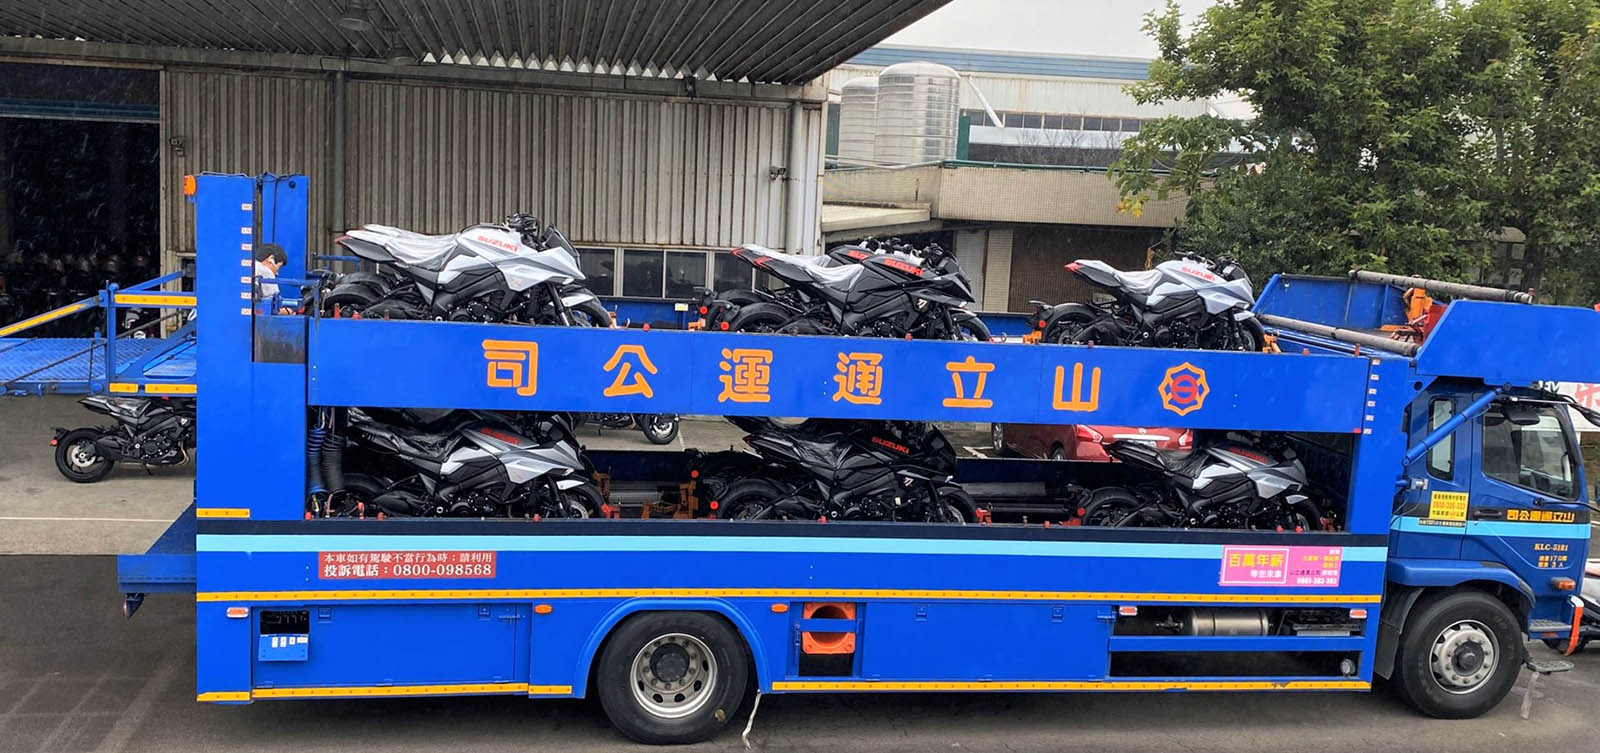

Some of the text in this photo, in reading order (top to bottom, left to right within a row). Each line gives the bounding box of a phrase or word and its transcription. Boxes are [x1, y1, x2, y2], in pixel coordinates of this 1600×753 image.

[477, 235, 518, 252] SUZUKI
[883, 257, 925, 277] SUZUKI
[871, 436, 910, 455] SUZUKI
[1229, 552, 1284, 568] 百萬年薪
